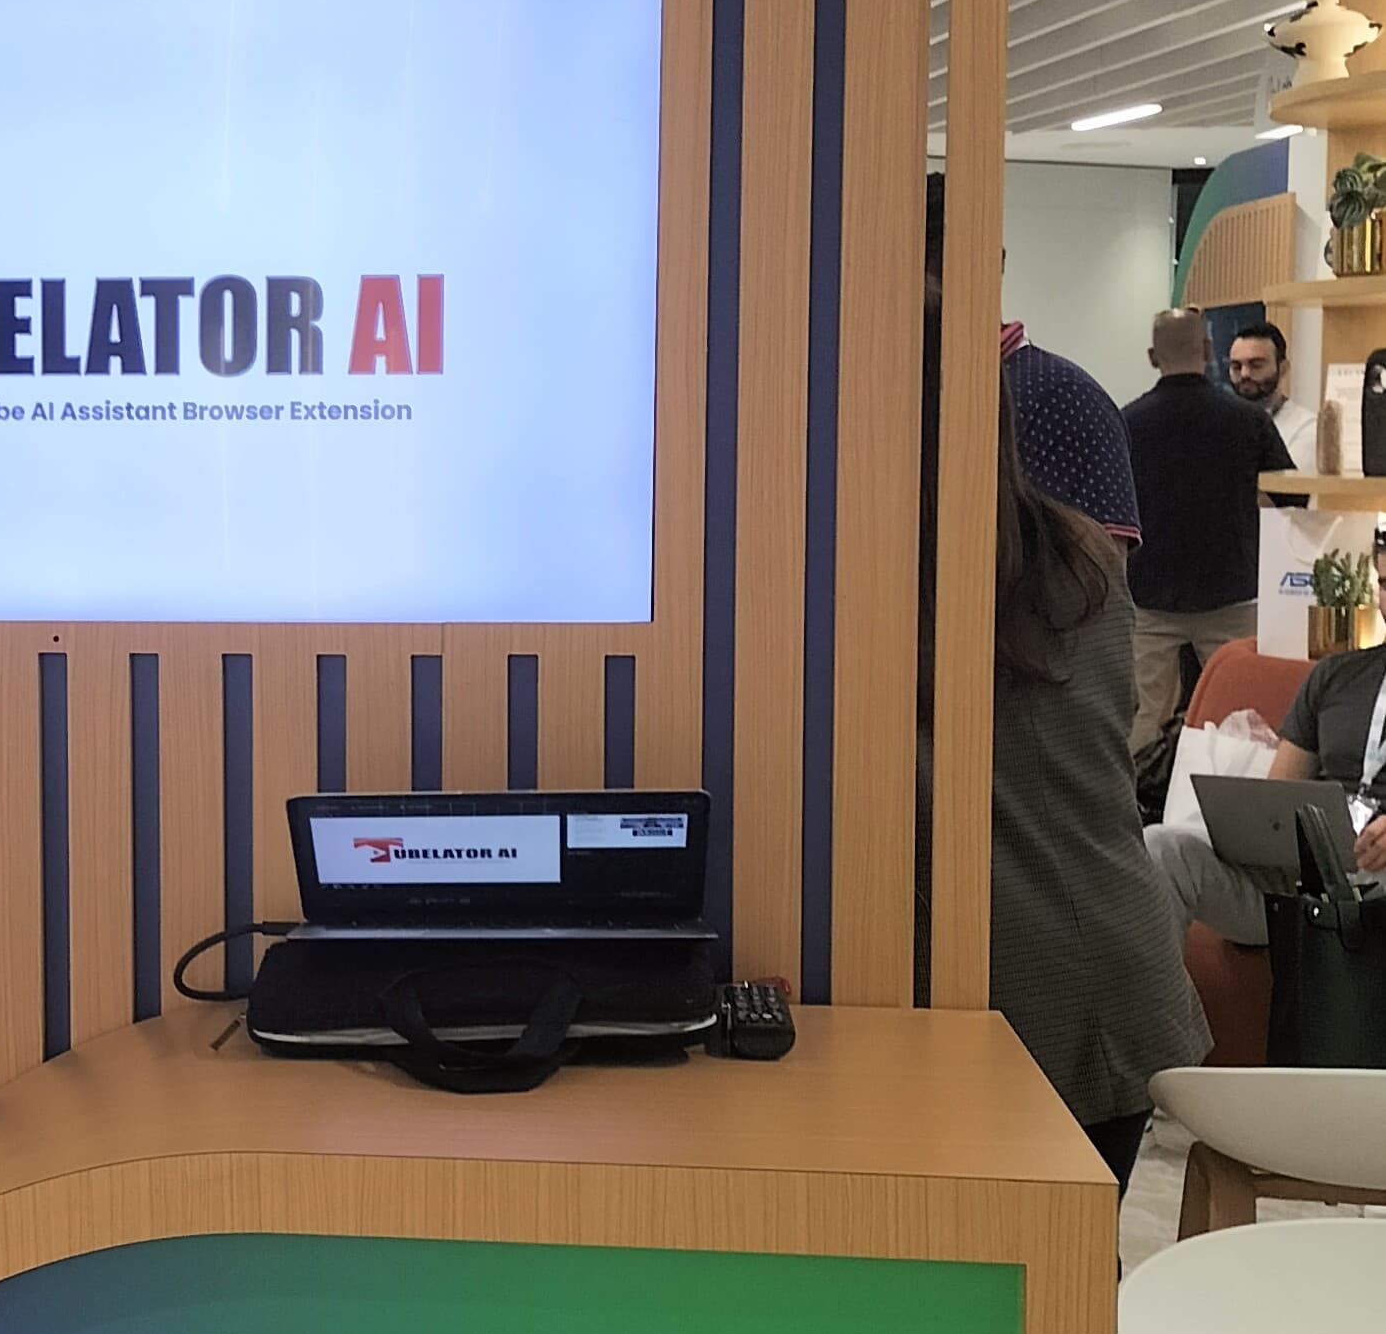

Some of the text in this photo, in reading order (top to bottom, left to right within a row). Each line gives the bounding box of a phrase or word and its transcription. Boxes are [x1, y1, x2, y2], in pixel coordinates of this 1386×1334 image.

[348, 273, 445, 375] AI
[31, 402, 55, 421] AI
[61, 400, 177, 421] Assistant
[182, 400, 285, 421] Browser
[289, 400, 413, 421] Extension
[498, 848, 518, 859] AI
